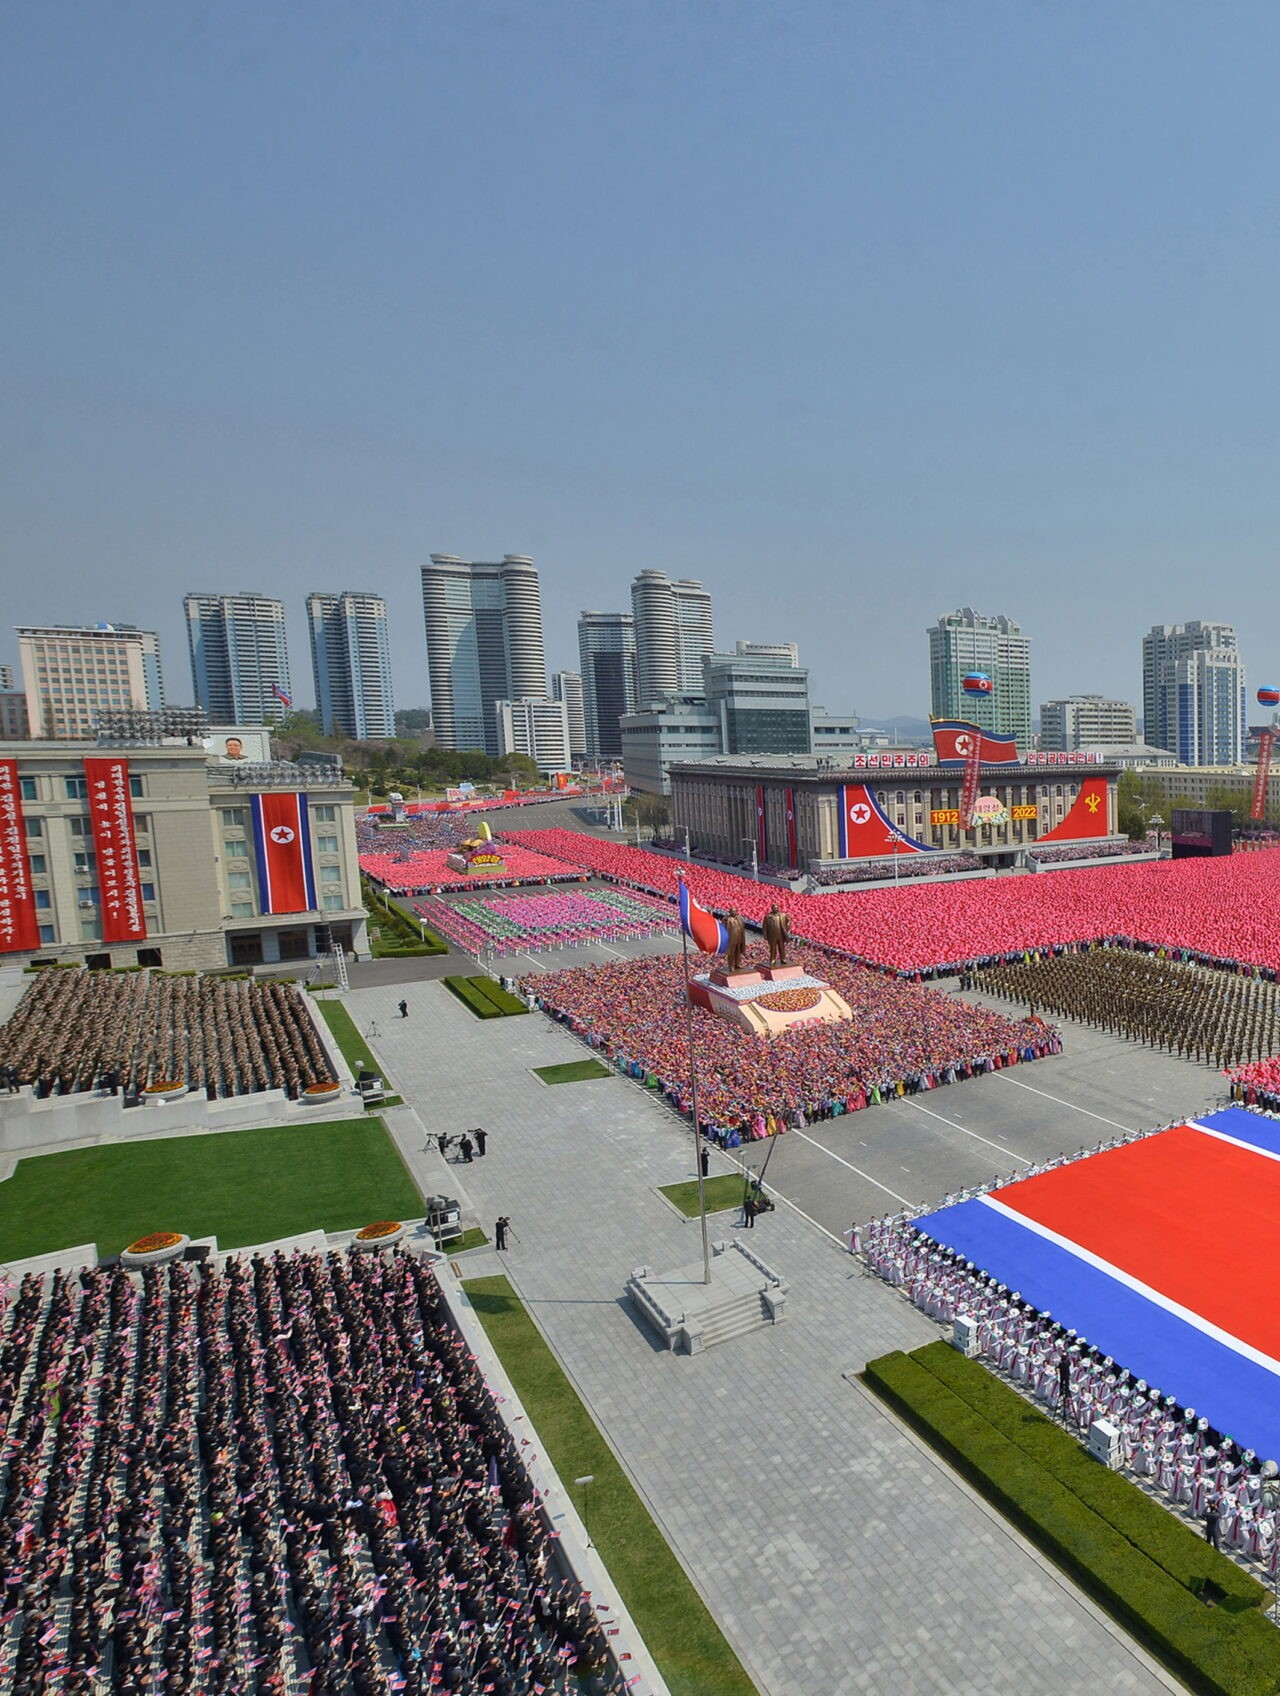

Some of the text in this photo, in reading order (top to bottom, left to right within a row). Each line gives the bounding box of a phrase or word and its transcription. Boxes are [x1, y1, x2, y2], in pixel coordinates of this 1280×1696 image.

[855, 754, 929, 768] 조선민주주의
[932, 811, 959, 822] 1912
[1013, 807, 1036, 818] 2022
